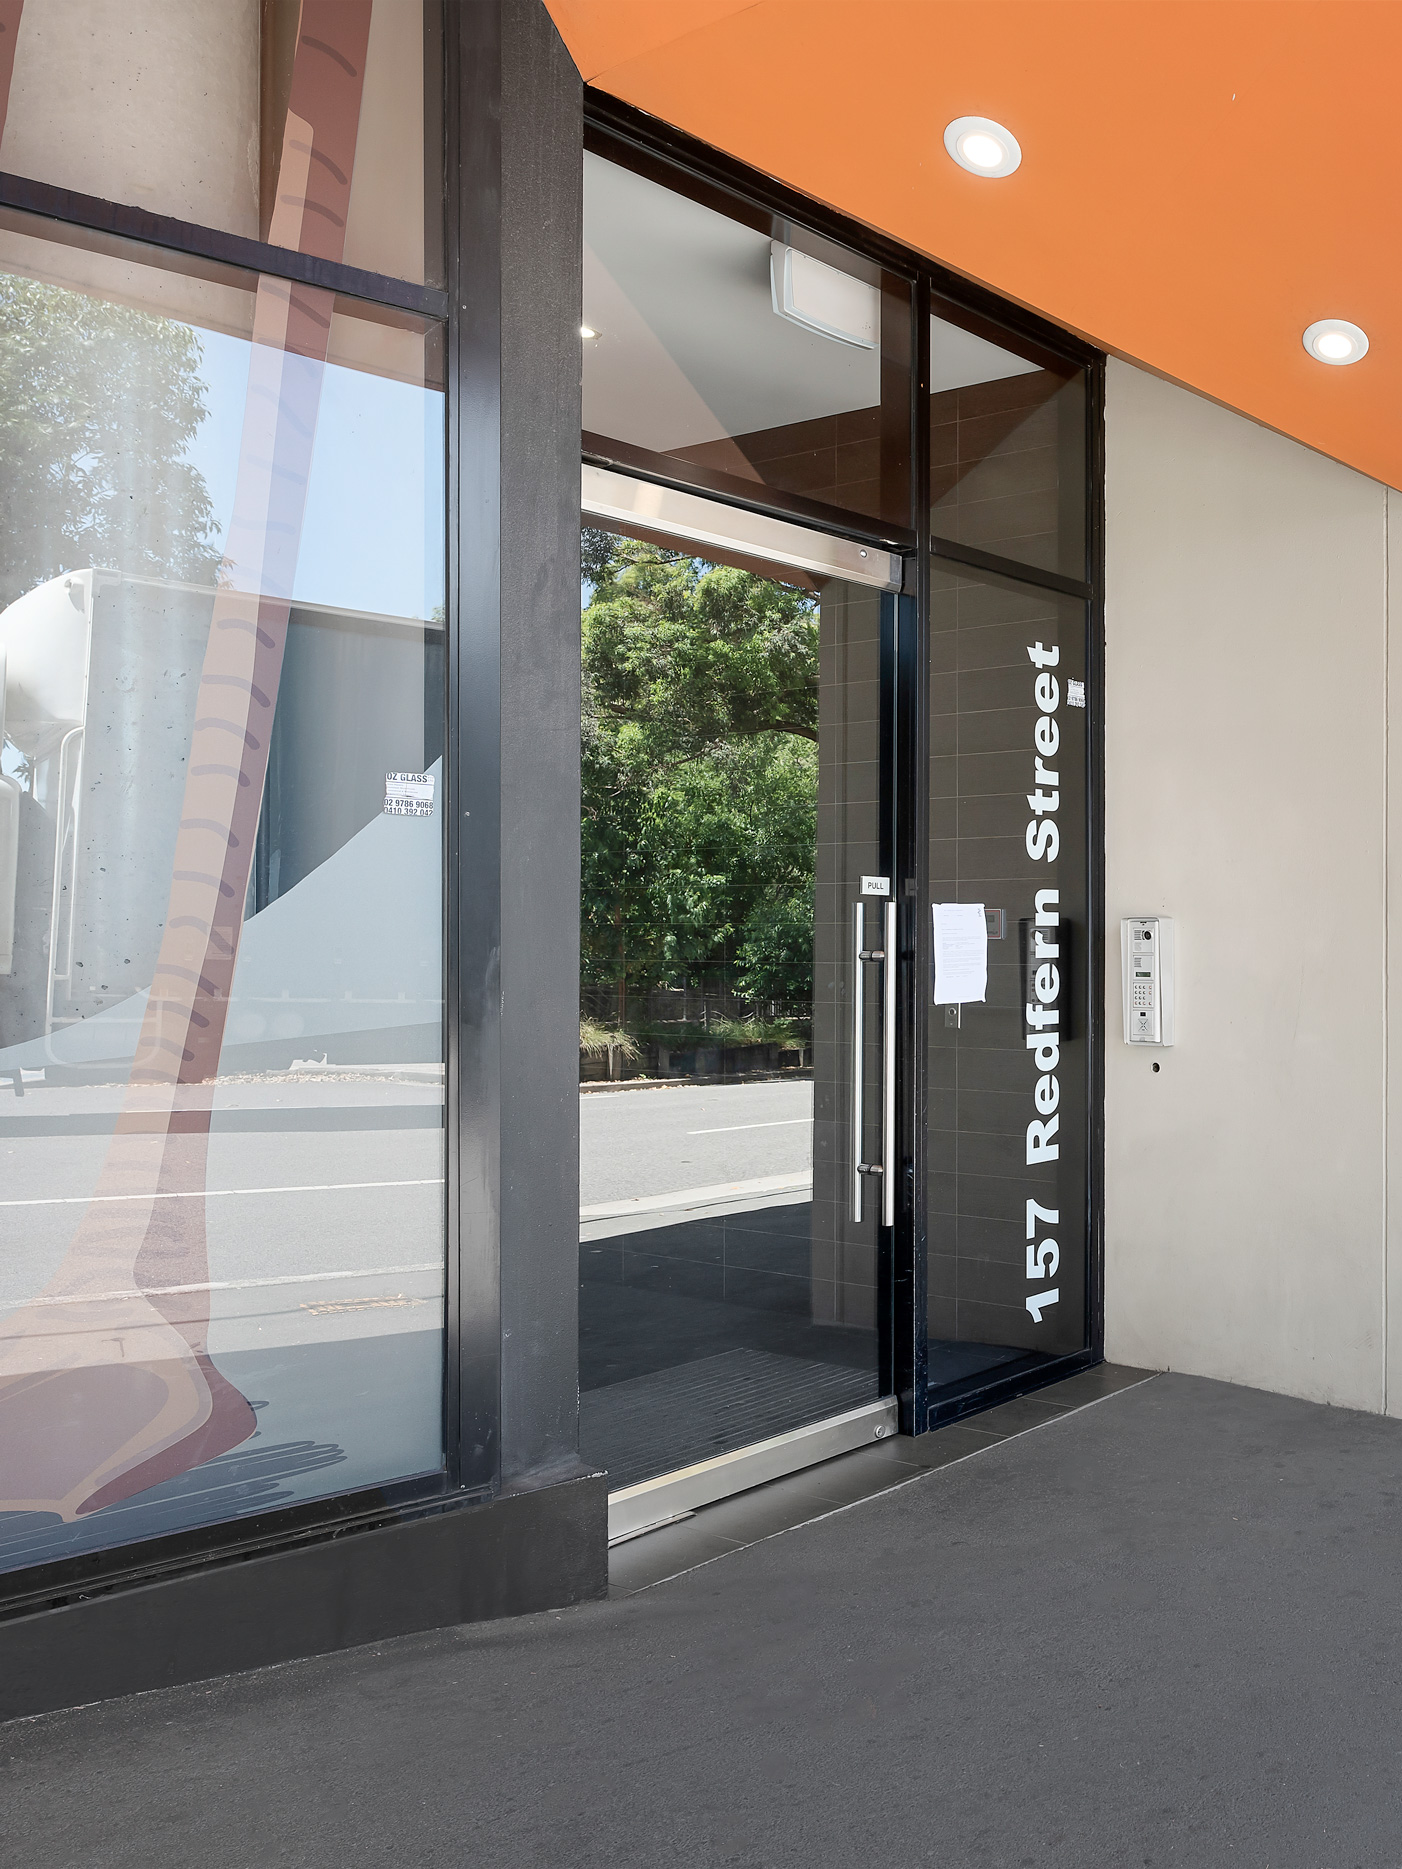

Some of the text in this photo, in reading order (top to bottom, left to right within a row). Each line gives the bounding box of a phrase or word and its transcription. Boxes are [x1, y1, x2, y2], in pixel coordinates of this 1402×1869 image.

[400, 774, 428, 783] GLASS
[395, 800, 414, 808] 9786
[867, 881, 884, 890] PULL
[1025, 641, 1060, 1323] 157 Redfern Street
